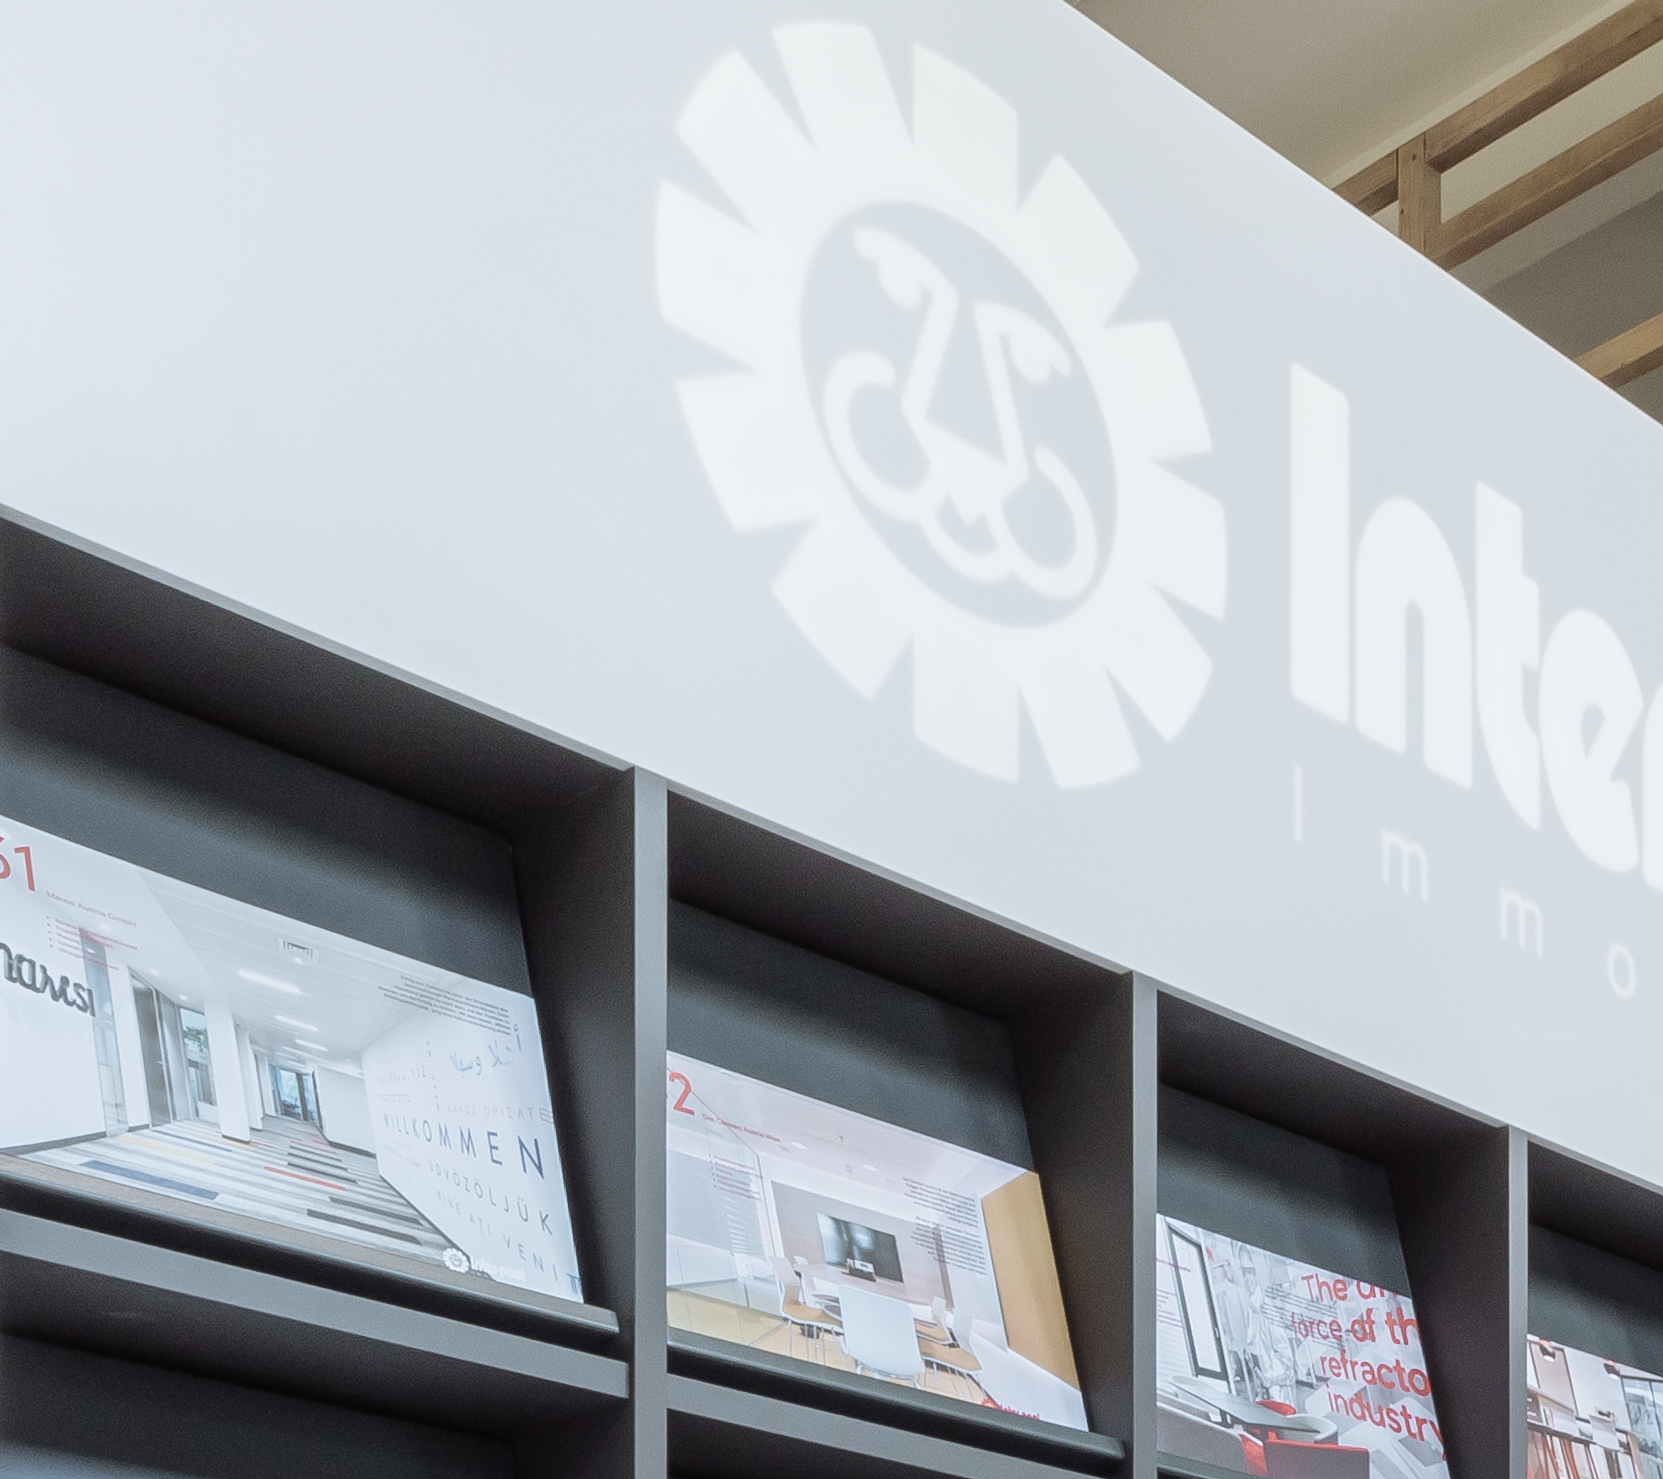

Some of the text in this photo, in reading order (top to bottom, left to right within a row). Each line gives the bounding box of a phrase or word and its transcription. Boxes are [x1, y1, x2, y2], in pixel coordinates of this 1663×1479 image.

[666, 1071, 695, 1116] 2
[382, 1111, 545, 1180] WILLKOMMEN
[1301, 1273, 1348, 1303] The
[1291, 1311, 1343, 1341] force
[1350, 1308, 1376, 1343] of
